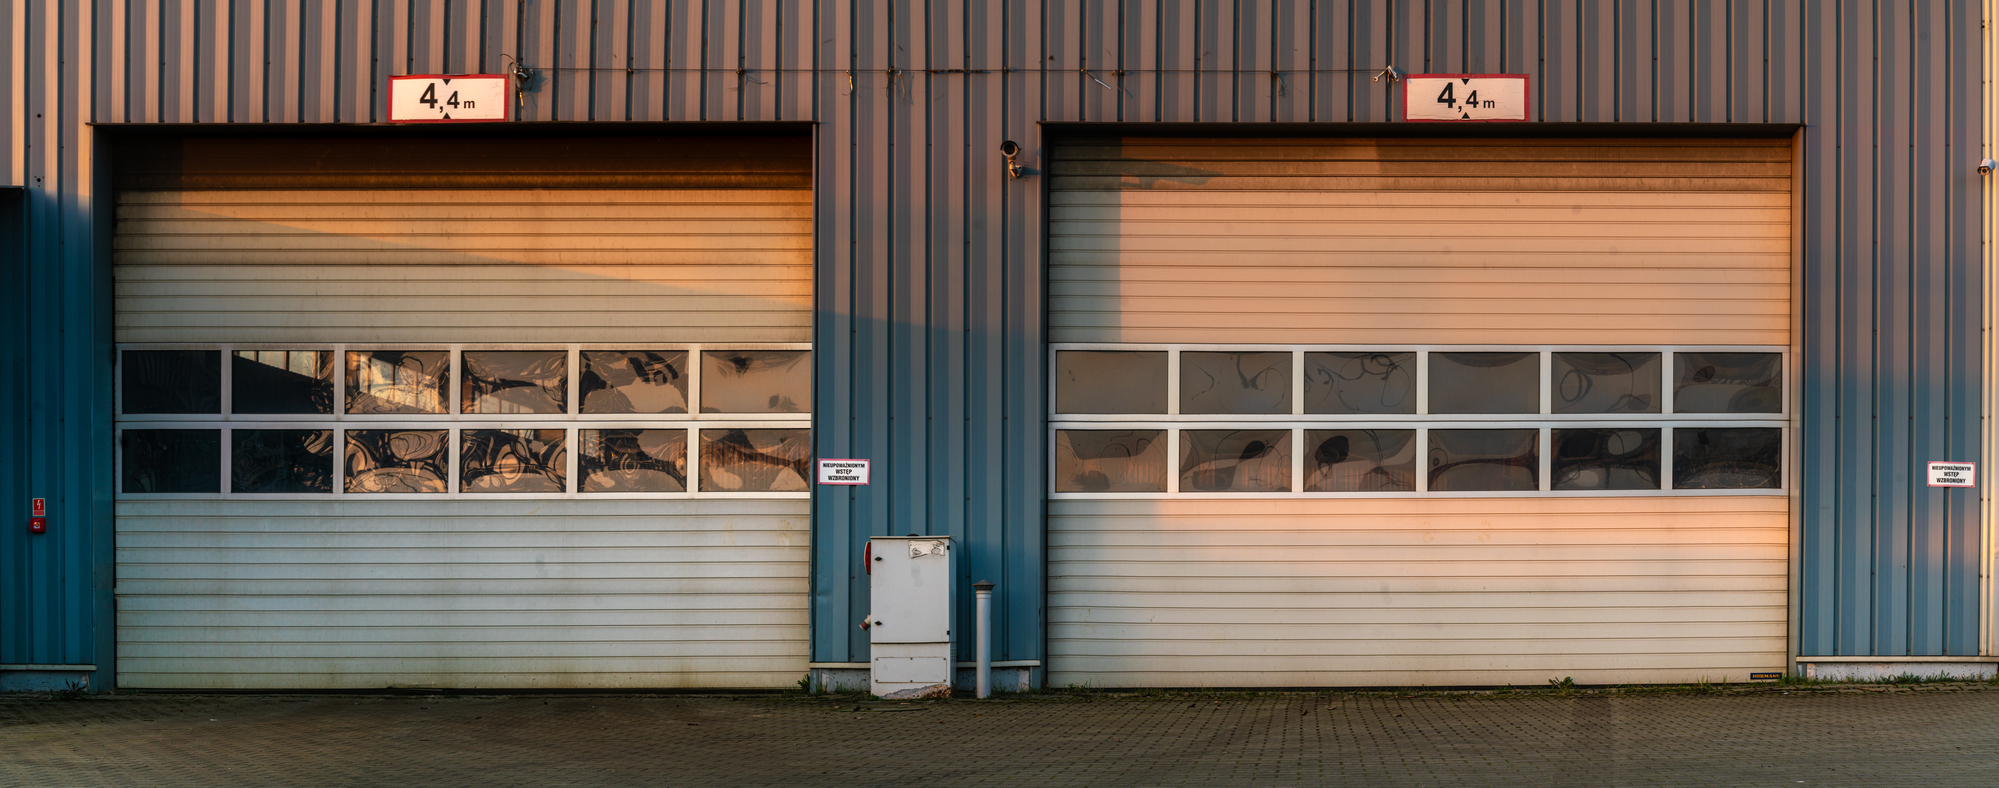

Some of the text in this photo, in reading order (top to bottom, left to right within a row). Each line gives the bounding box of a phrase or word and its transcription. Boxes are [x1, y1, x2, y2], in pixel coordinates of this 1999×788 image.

[419, 82, 475, 113] 4,4 m
[1437, 82, 1495, 112] 4,4 m
